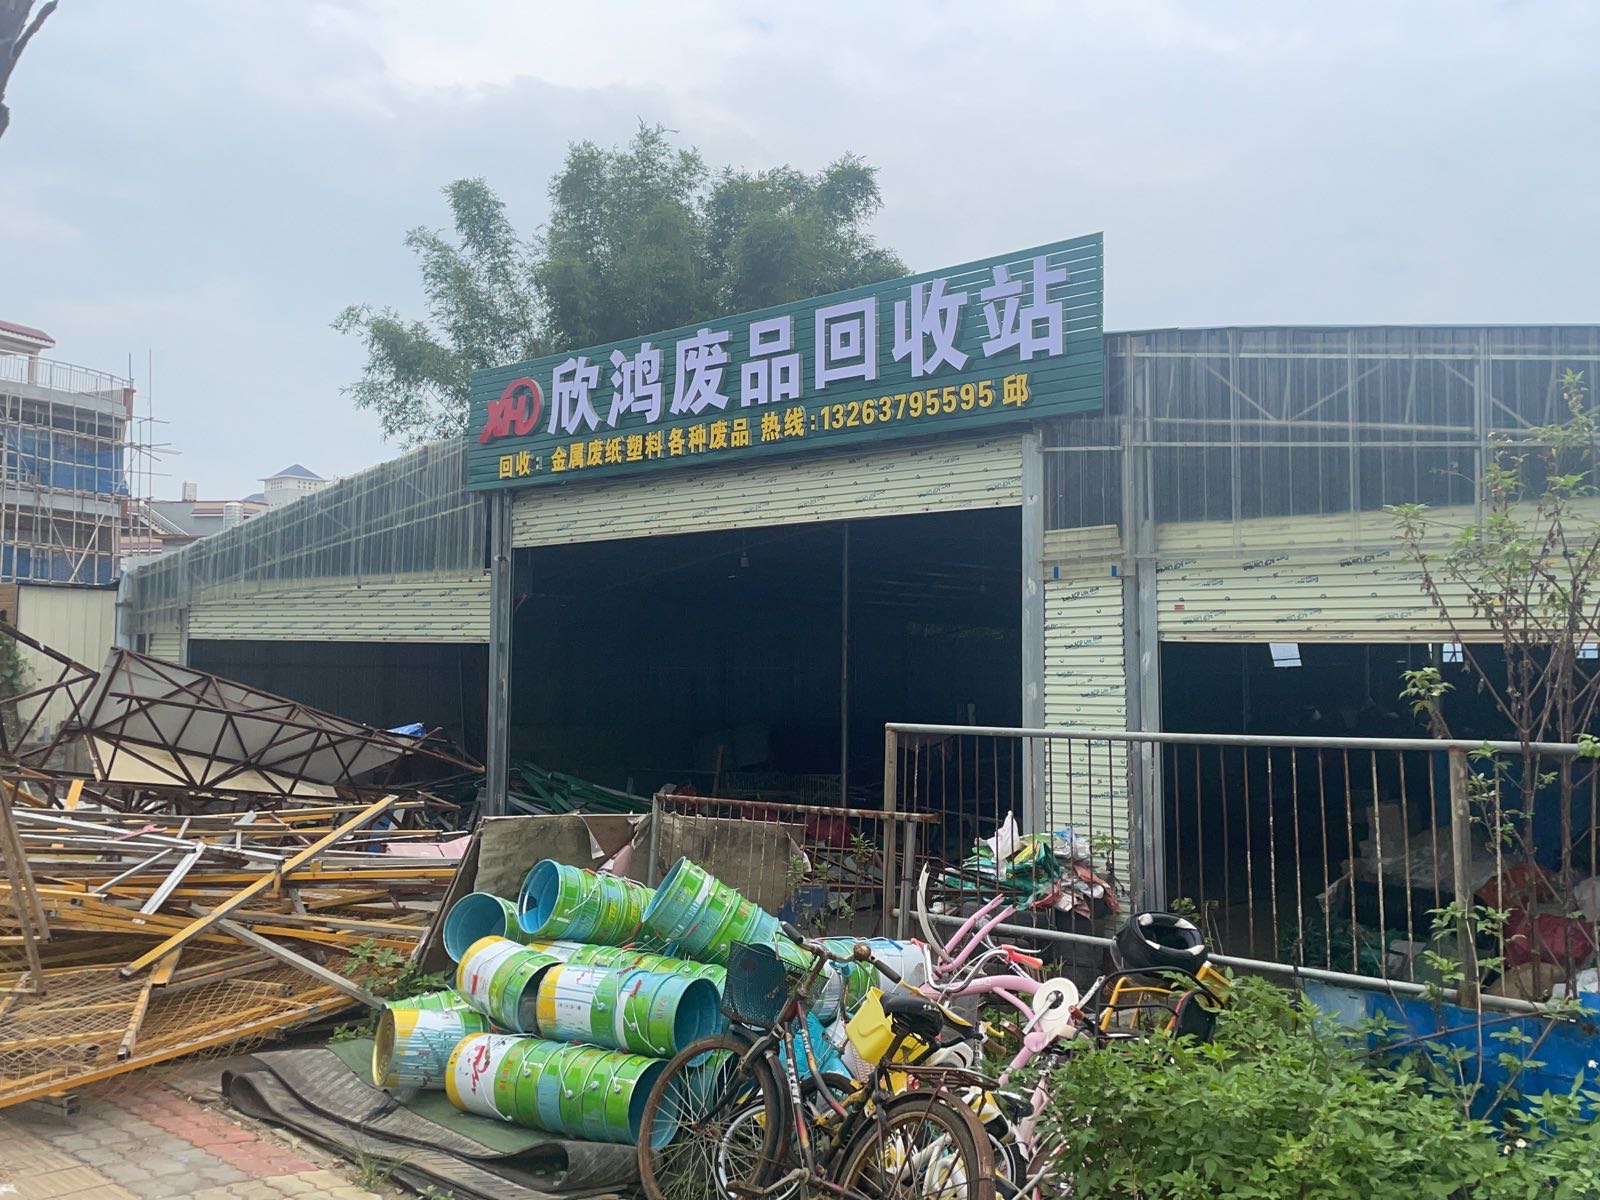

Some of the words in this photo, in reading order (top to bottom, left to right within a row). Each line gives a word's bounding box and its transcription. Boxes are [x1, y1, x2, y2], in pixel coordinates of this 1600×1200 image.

[547, 255, 1069, 436] 欣鸿废品回收站
[1002, 372, 1030, 407] 邱
